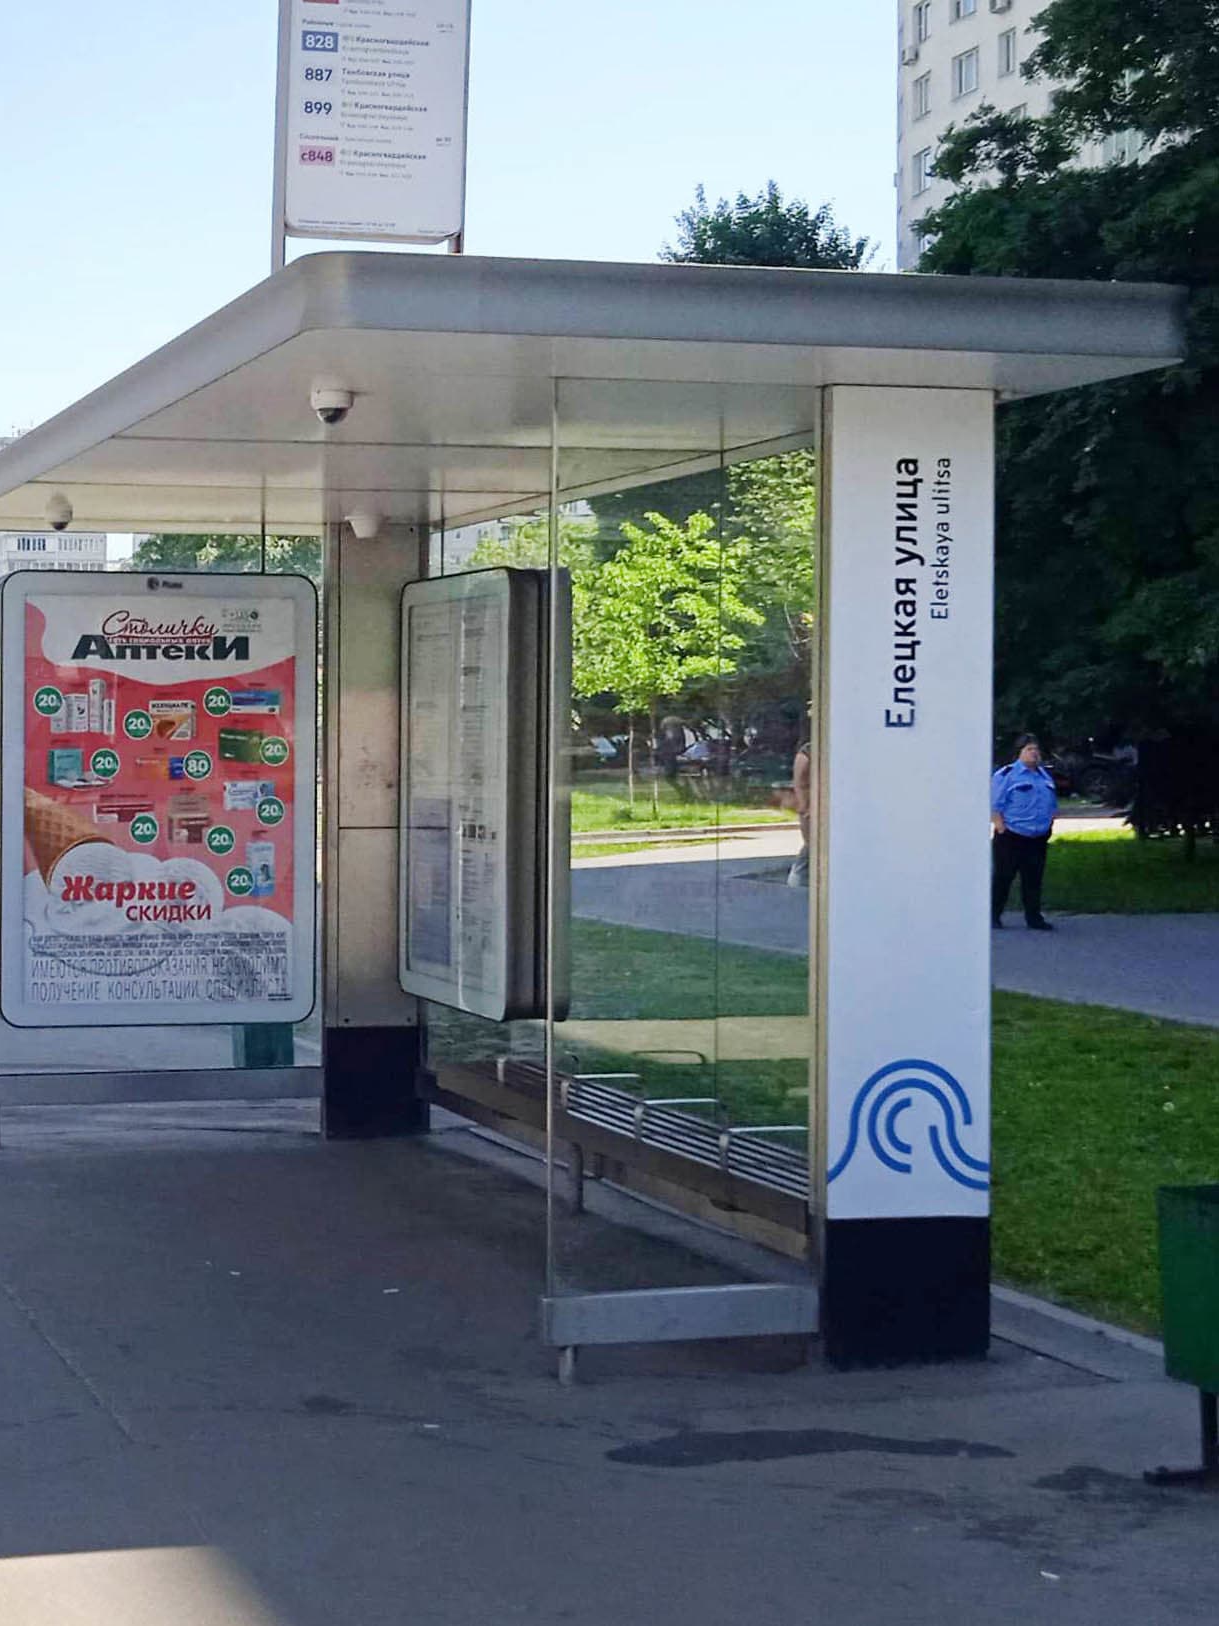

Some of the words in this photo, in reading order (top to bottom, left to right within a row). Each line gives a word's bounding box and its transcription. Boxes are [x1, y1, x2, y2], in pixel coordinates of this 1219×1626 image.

[305, 35, 334, 49] 828
[305, 68, 333, 82] 887
[304, 101, 332, 115] 899
[932, 458, 951, 514] ulitsa
[895, 457, 925, 566] улица
[930, 522, 953, 619] Eletskaya
[885, 578, 921, 728] Елецкая
[188, 760, 208, 772] 80
[61, 875, 196, 907] Жаркие
[31, 981, 100, 1002] ПОЛУЧЕНИЕ
[108, 979, 198, 1000] КОНСУЛЬТАЦИИ
